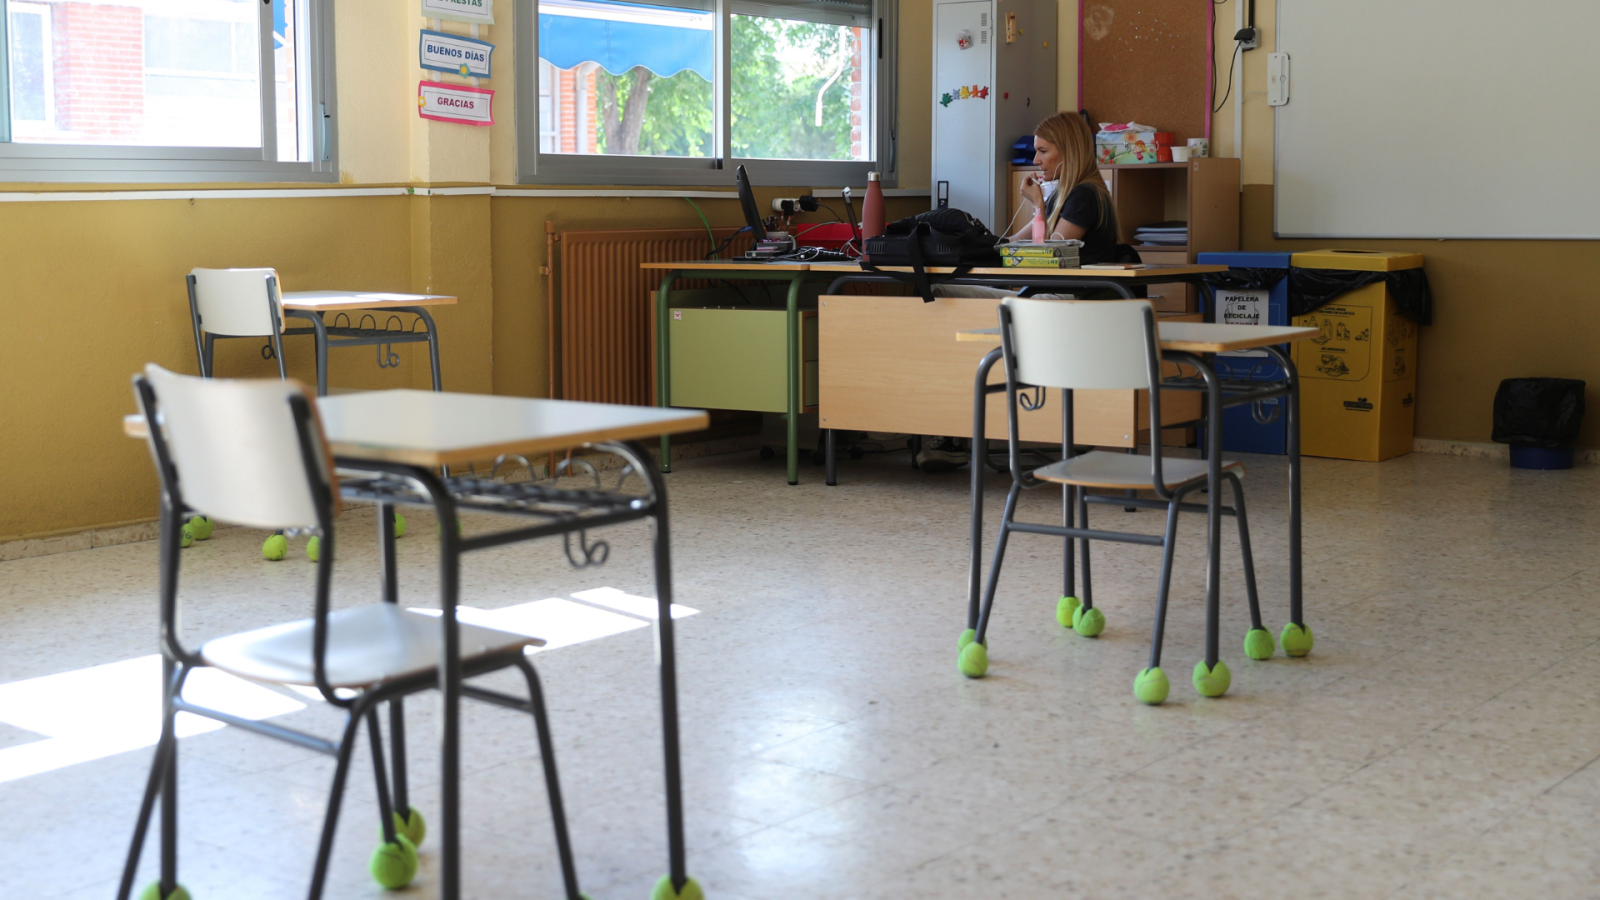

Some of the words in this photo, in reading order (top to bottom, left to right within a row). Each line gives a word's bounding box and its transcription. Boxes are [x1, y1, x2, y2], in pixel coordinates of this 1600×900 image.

[427, 44, 462, 58] BUENOS
[465, 50, 485, 62] DÍAS
[437, 97, 475, 109] GRACIAS
